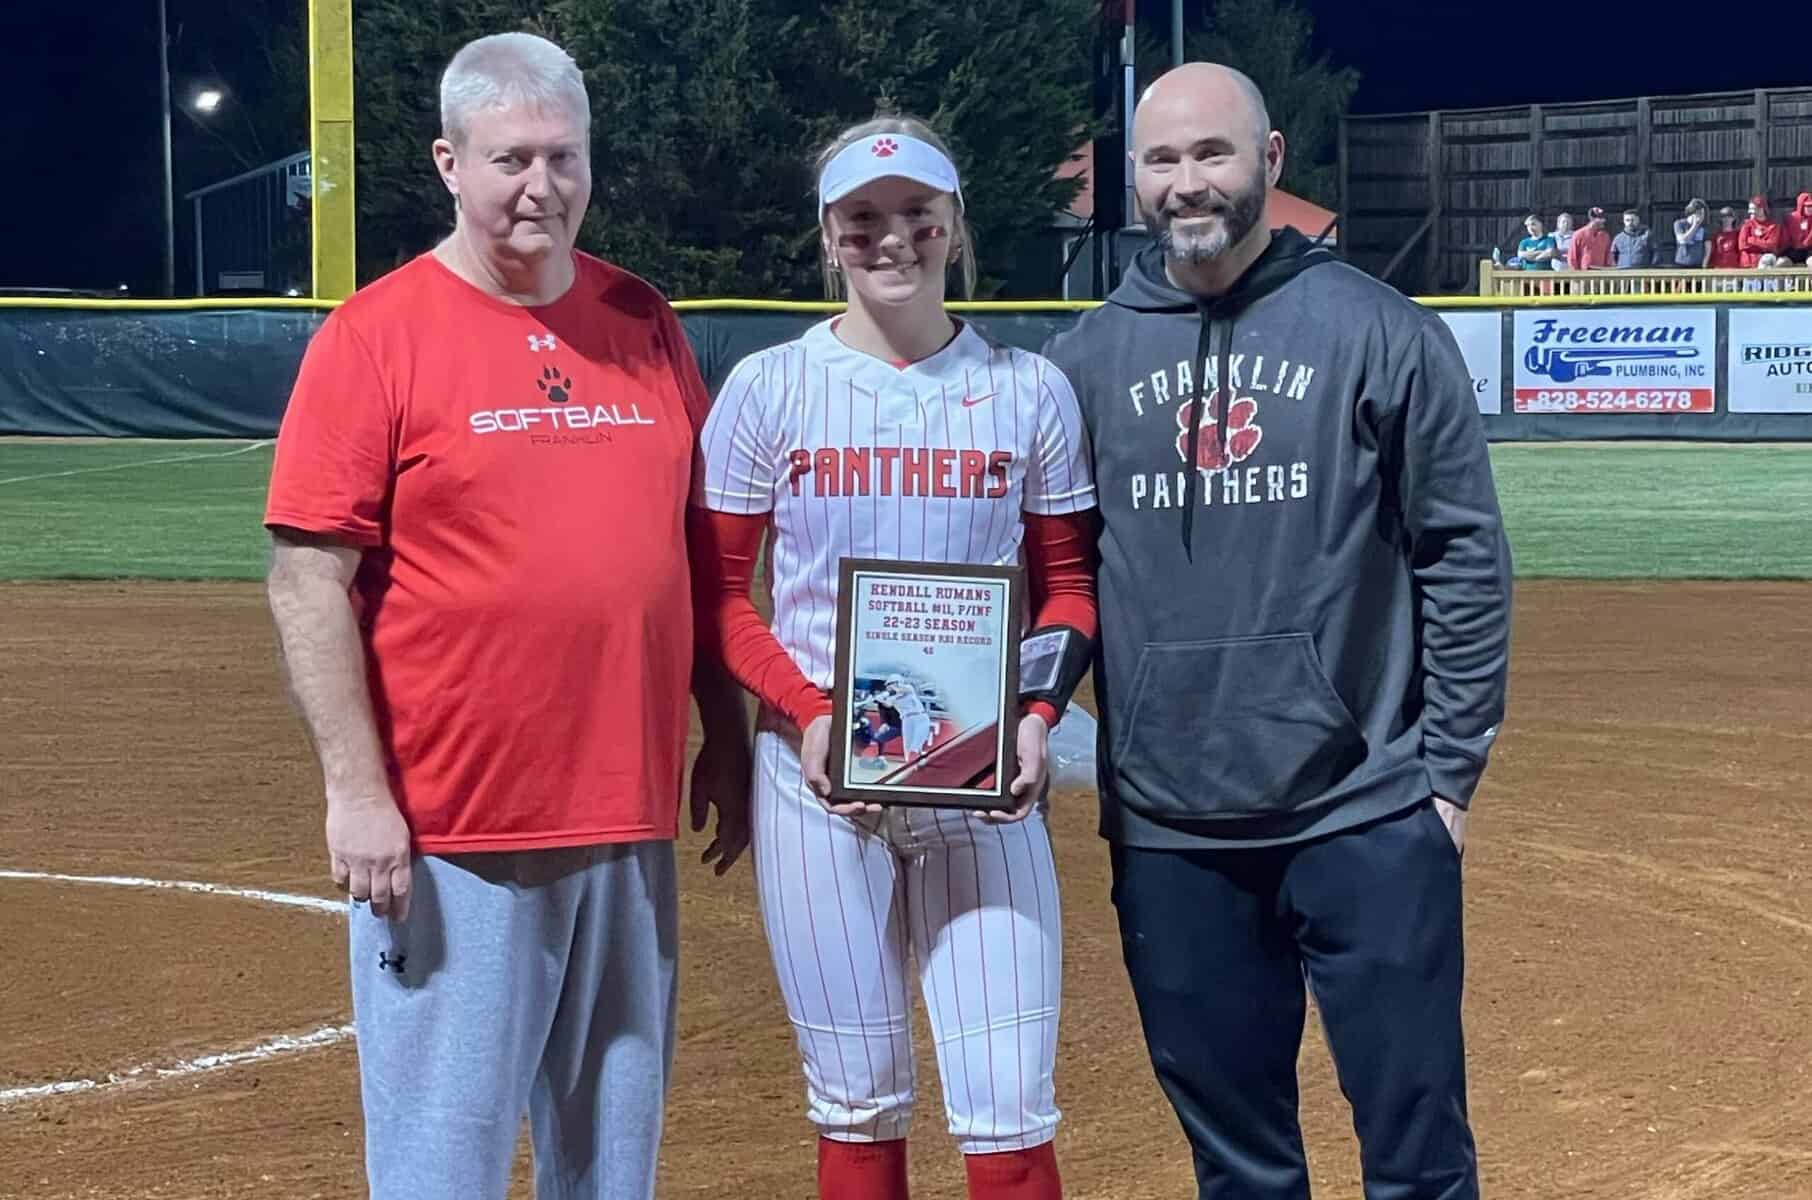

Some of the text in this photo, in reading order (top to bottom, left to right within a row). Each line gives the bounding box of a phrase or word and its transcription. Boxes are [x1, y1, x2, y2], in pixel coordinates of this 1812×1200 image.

[1533, 319, 1696, 344] Freeman
[1616, 364, 1682, 379] PLUMBING,
[1129, 354, 1315, 416] FRANKLIN
[1536, 391, 1693, 409] 828-524-6278
[469, 403, 656, 434] SOFTBALL
[530, 432, 614, 445] FRANKLIN
[789, 447, 1013, 499] PANTHERS
[871, 583, 992, 601] KENDALL RUMANS
[868, 599, 928, 614] SOFTBALL
[883, 616, 976, 632] 22-23 SEASON
